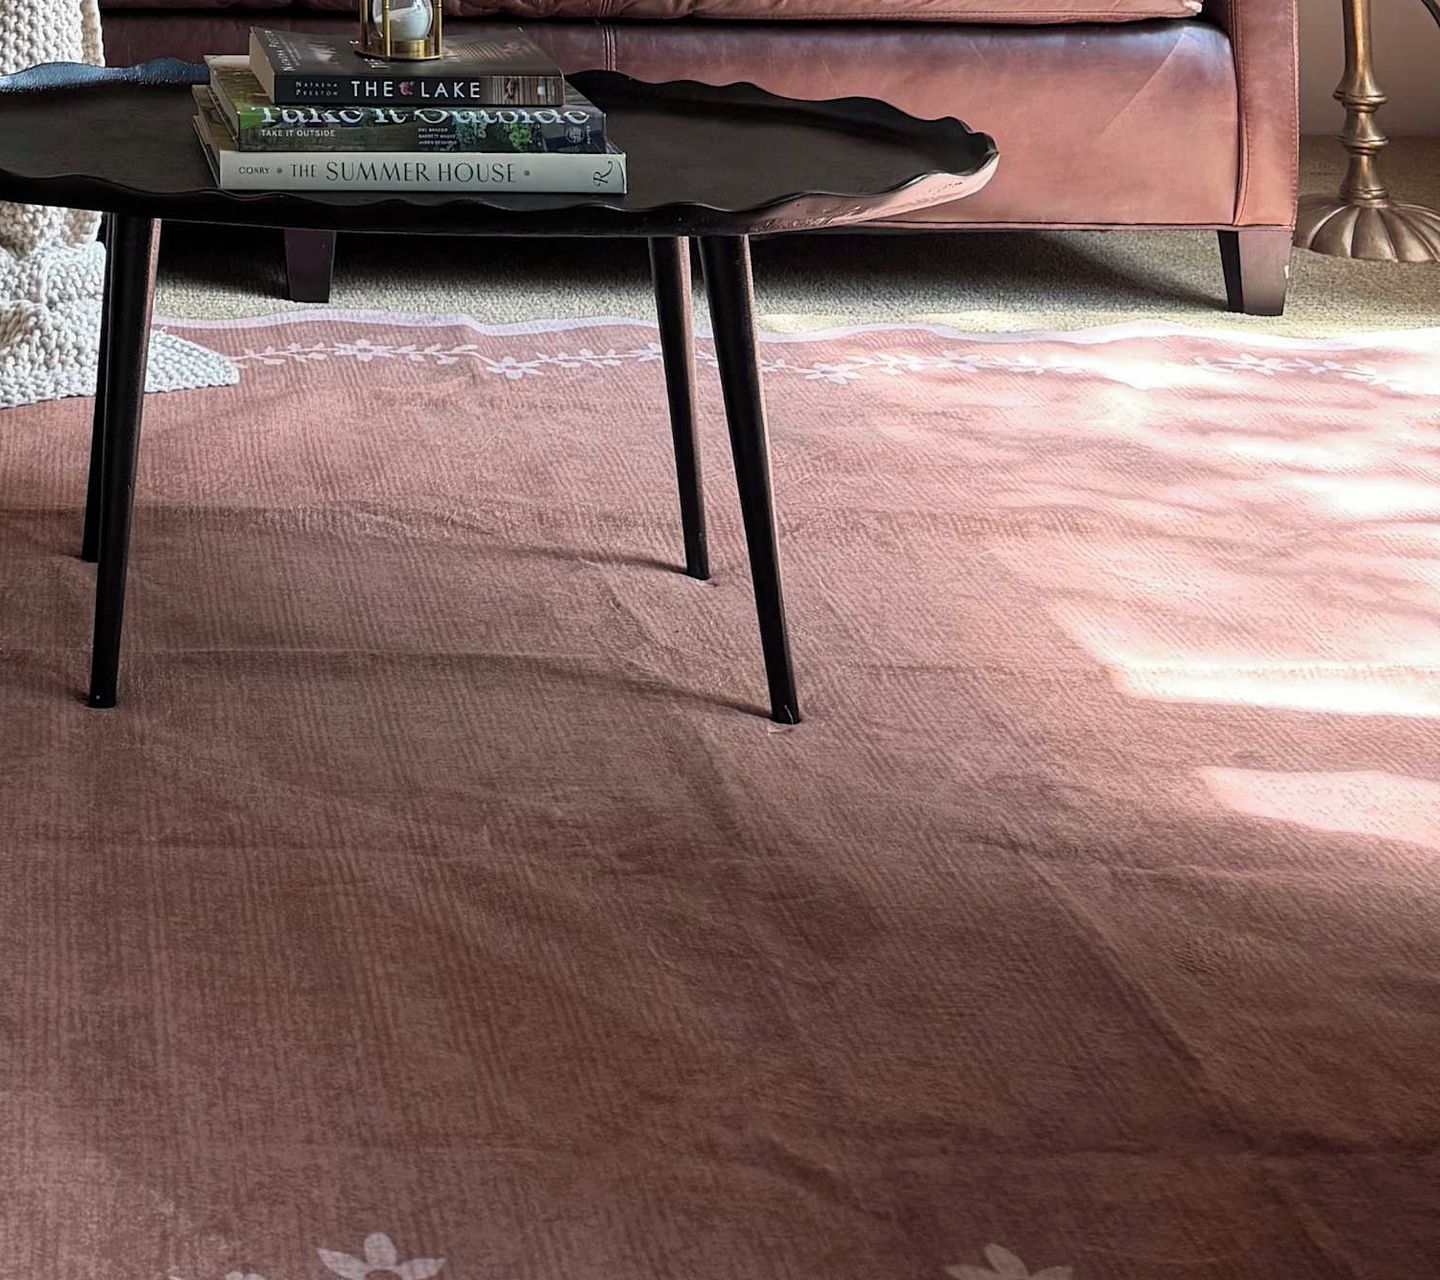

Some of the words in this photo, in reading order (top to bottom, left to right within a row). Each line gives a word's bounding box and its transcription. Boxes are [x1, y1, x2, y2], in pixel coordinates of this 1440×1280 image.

[350, 80, 394, 97] THE
[421, 81, 481, 98] LAKE
[260, 129, 283, 137] TAKE
[286, 129, 294, 137] IT
[296, 129, 336, 137] OUTSIDE
[289, 163, 317, 179] THE
[325, 161, 431, 182] SUMMER
[438, 162, 517, 183] HOUSE
